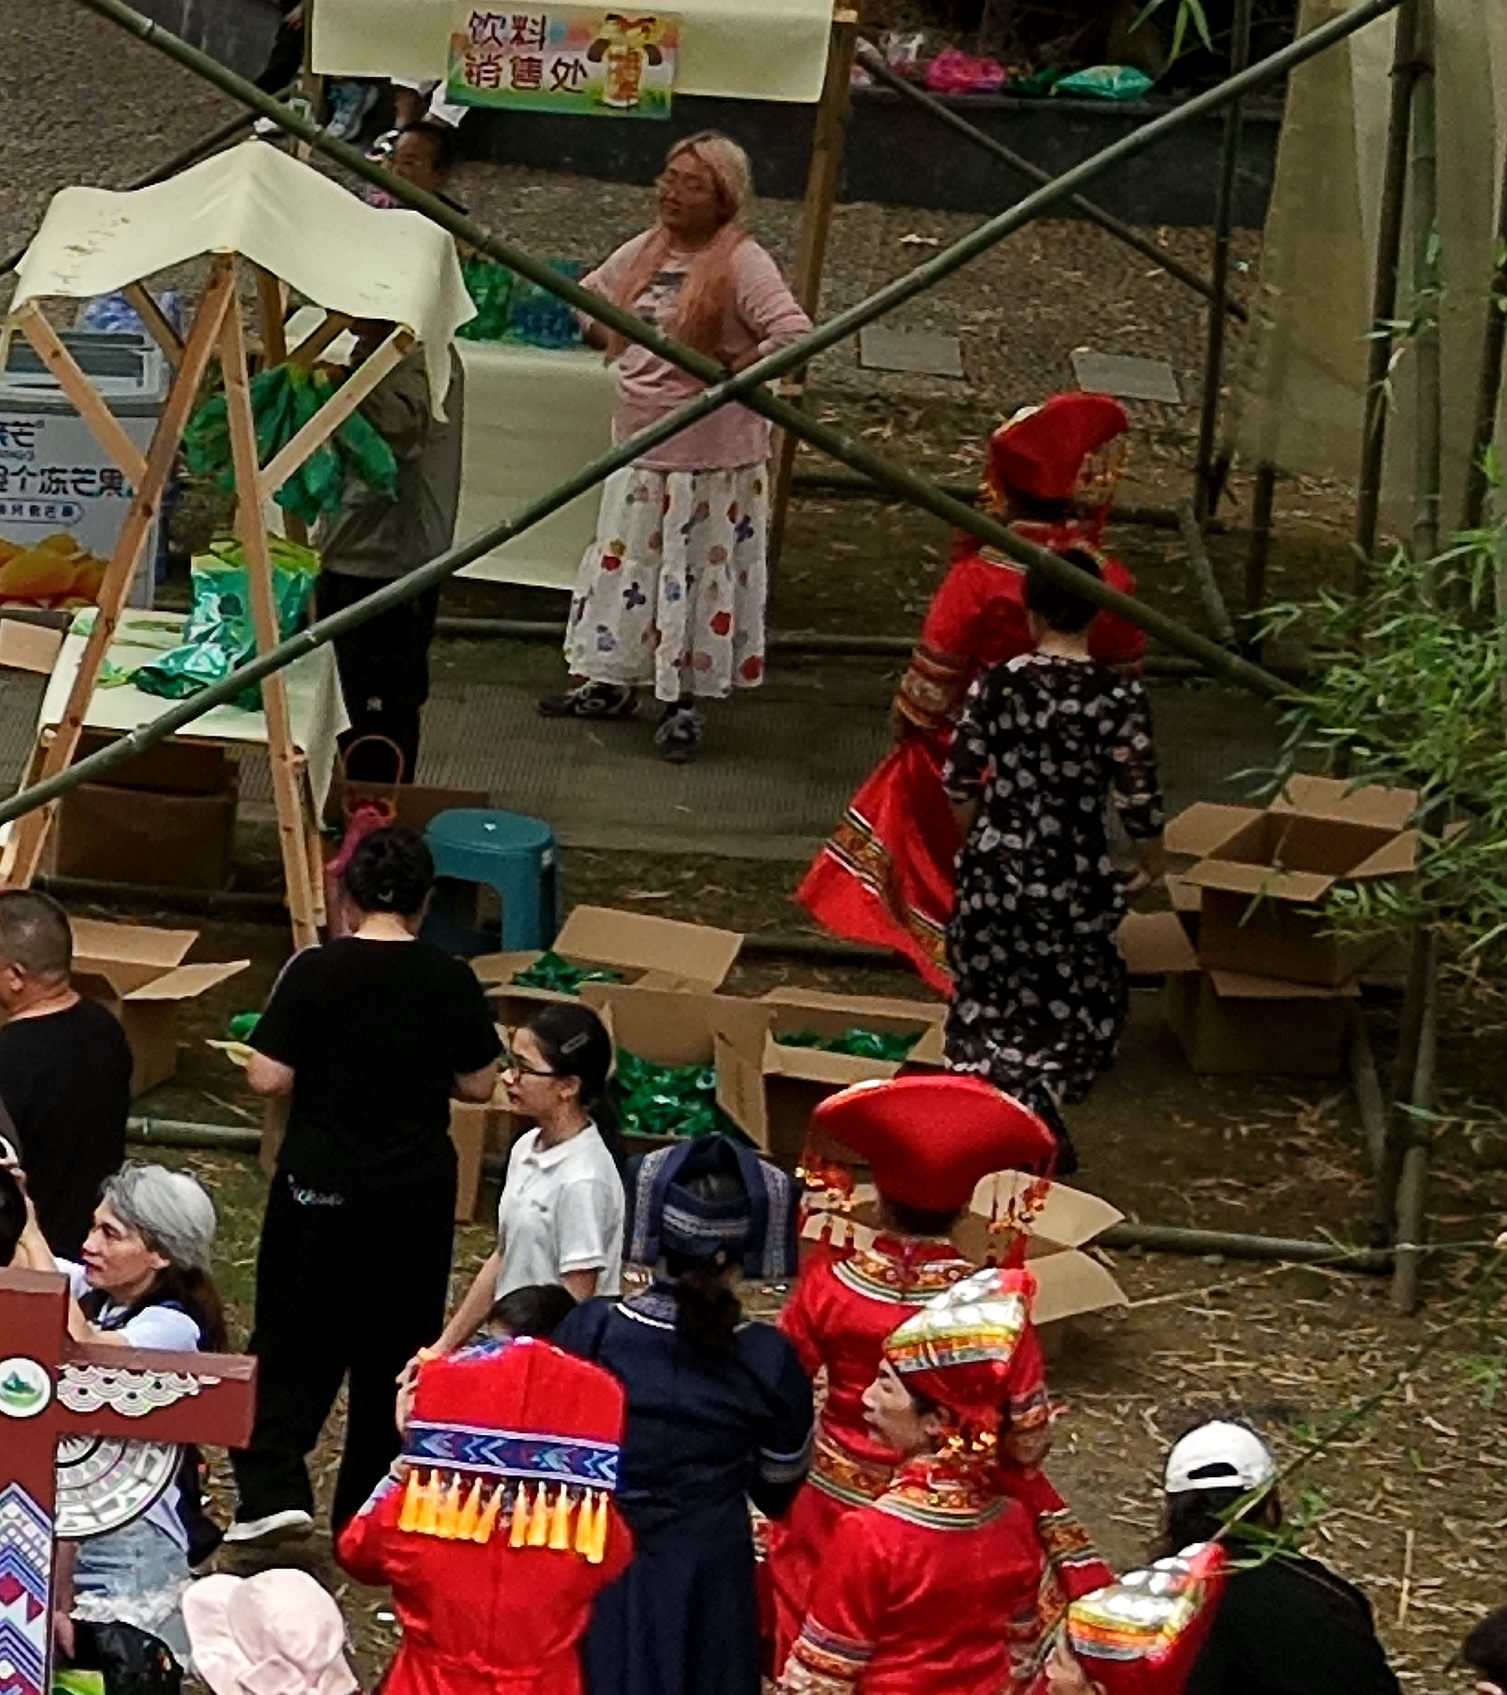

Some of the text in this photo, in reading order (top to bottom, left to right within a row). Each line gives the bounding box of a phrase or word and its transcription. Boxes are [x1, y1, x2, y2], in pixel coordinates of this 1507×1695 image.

[469, 10, 546, 50] 饮料
[464, 51, 588, 93] 销售处
